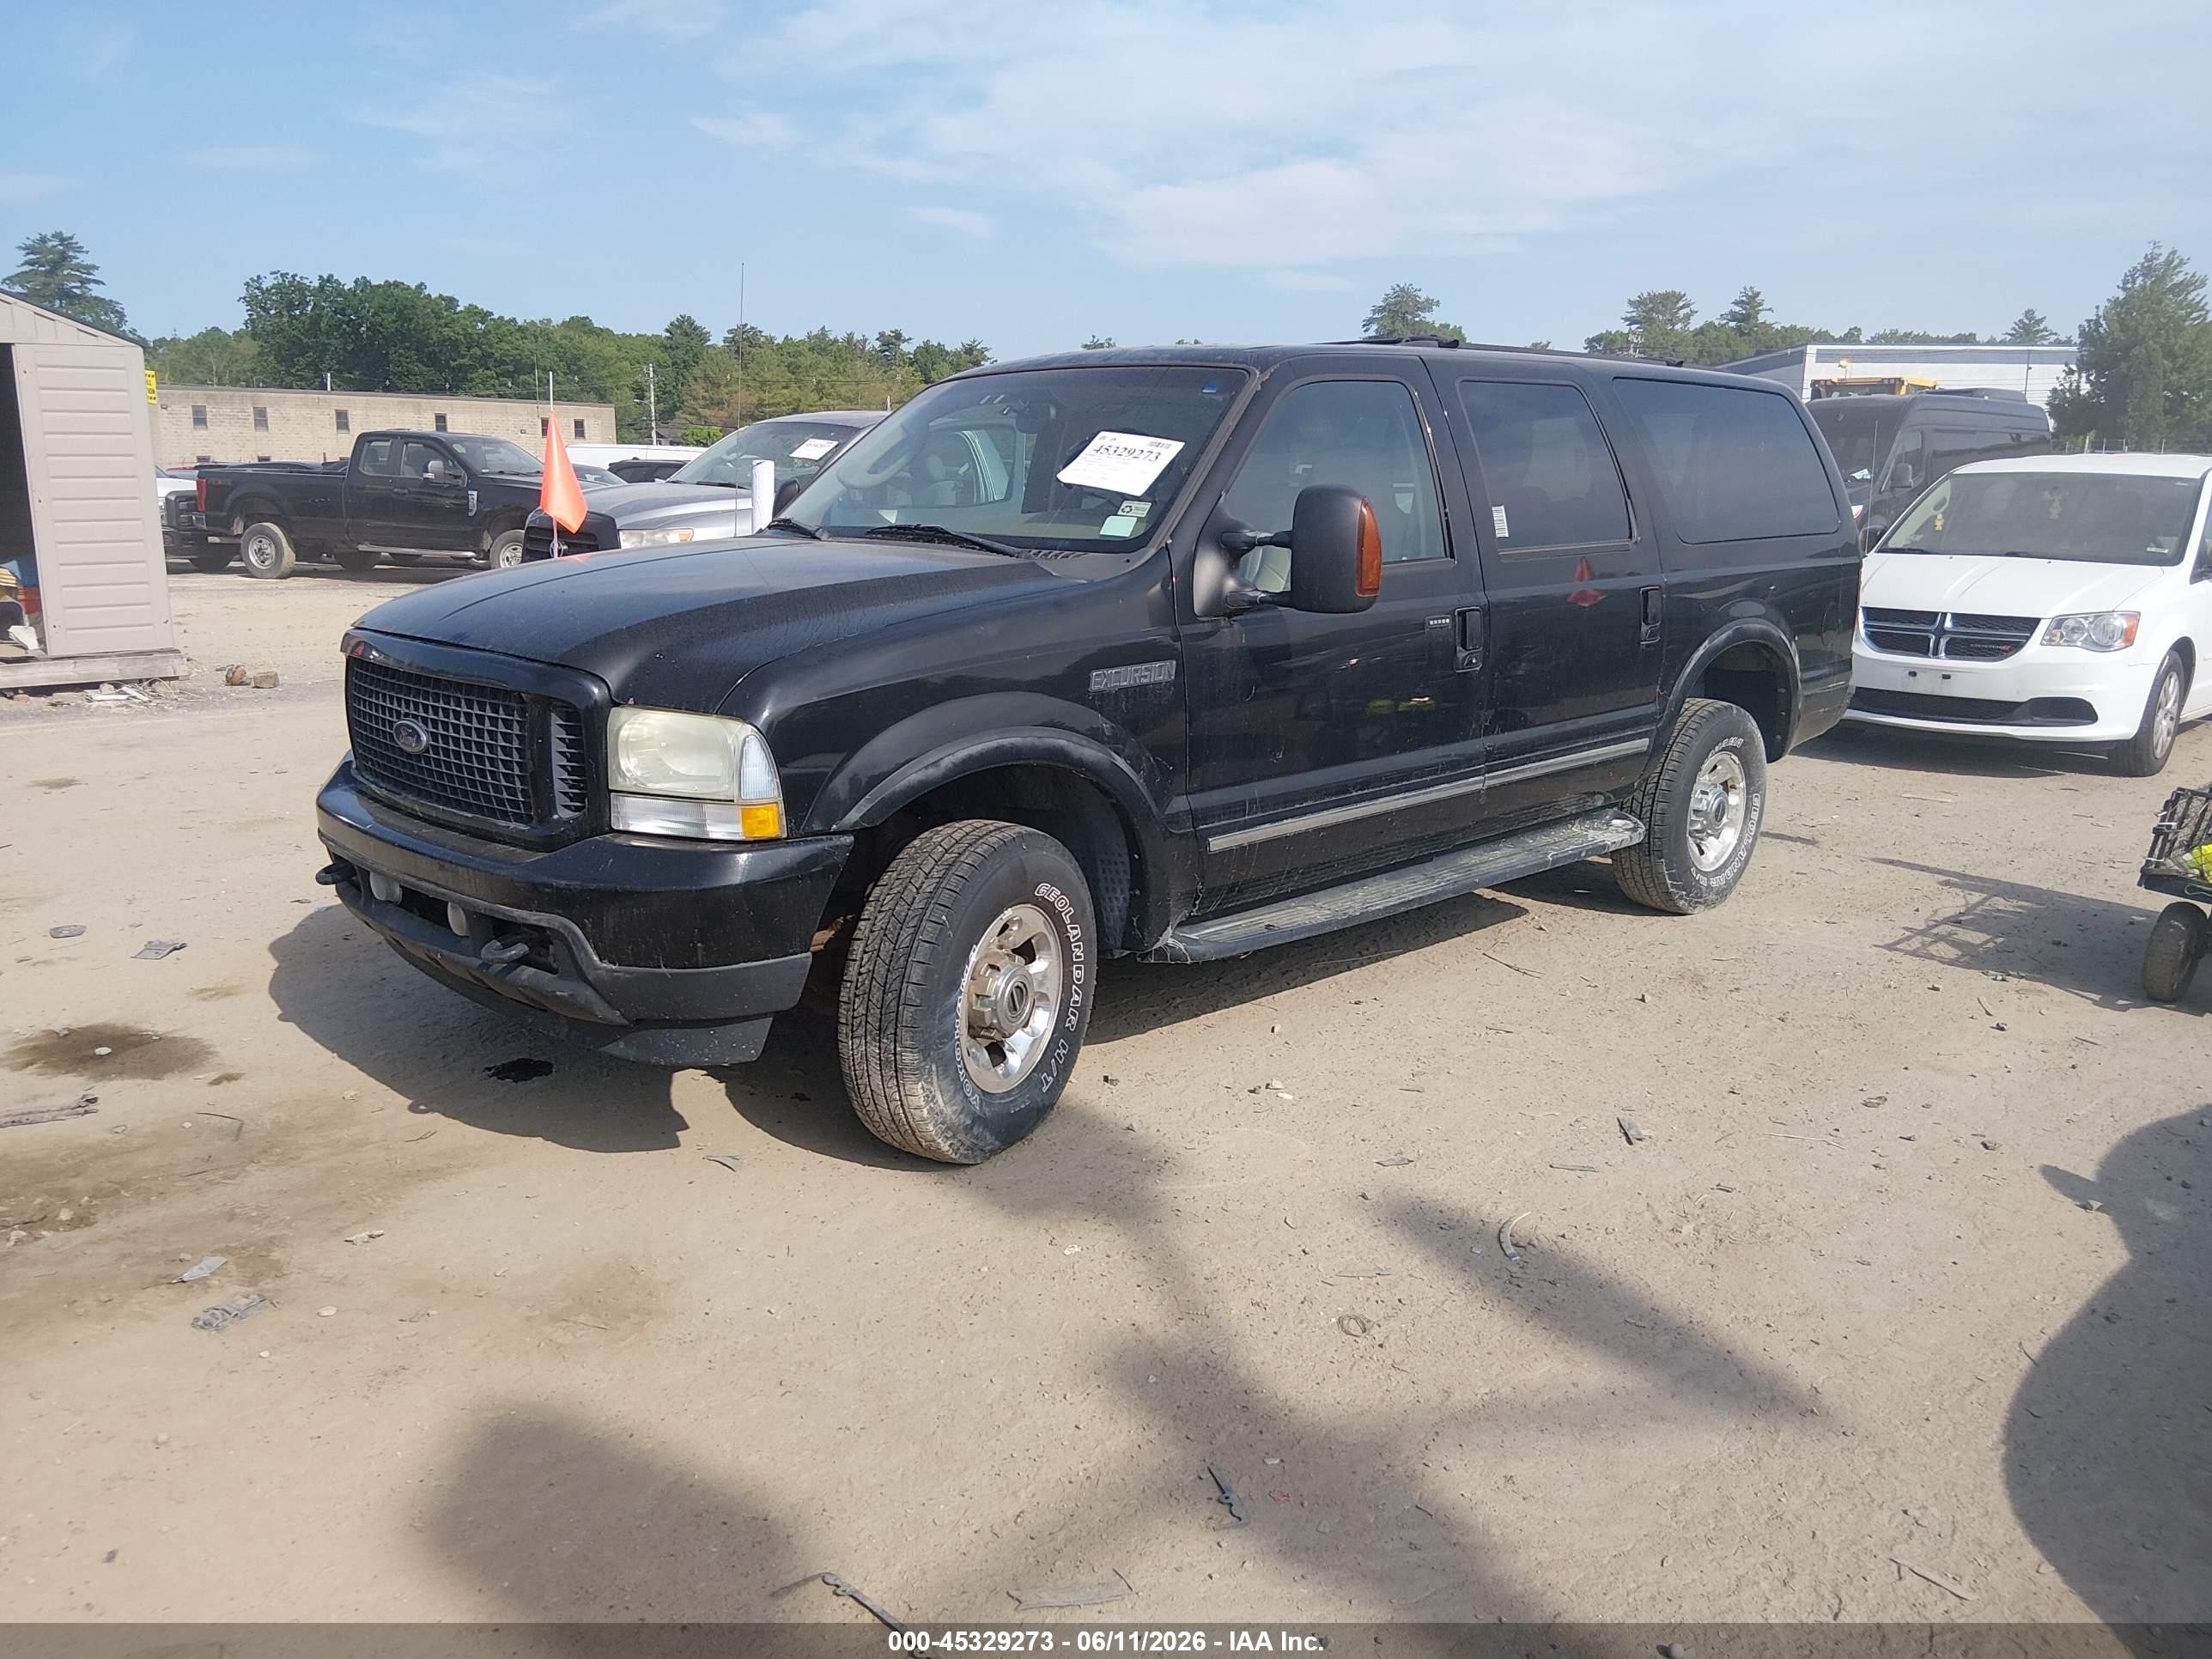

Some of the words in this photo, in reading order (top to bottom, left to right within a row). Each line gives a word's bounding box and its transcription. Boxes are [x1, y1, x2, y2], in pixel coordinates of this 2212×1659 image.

[1093, 444, 1162, 462] 45329273
[1091, 660, 1176, 690] EXCURSION
[1709, 793, 1760, 887] GEOLANDAR
[1035, 882, 1085, 1030] GEOLANDAR
[1042, 1038, 1069, 1093] H/T
